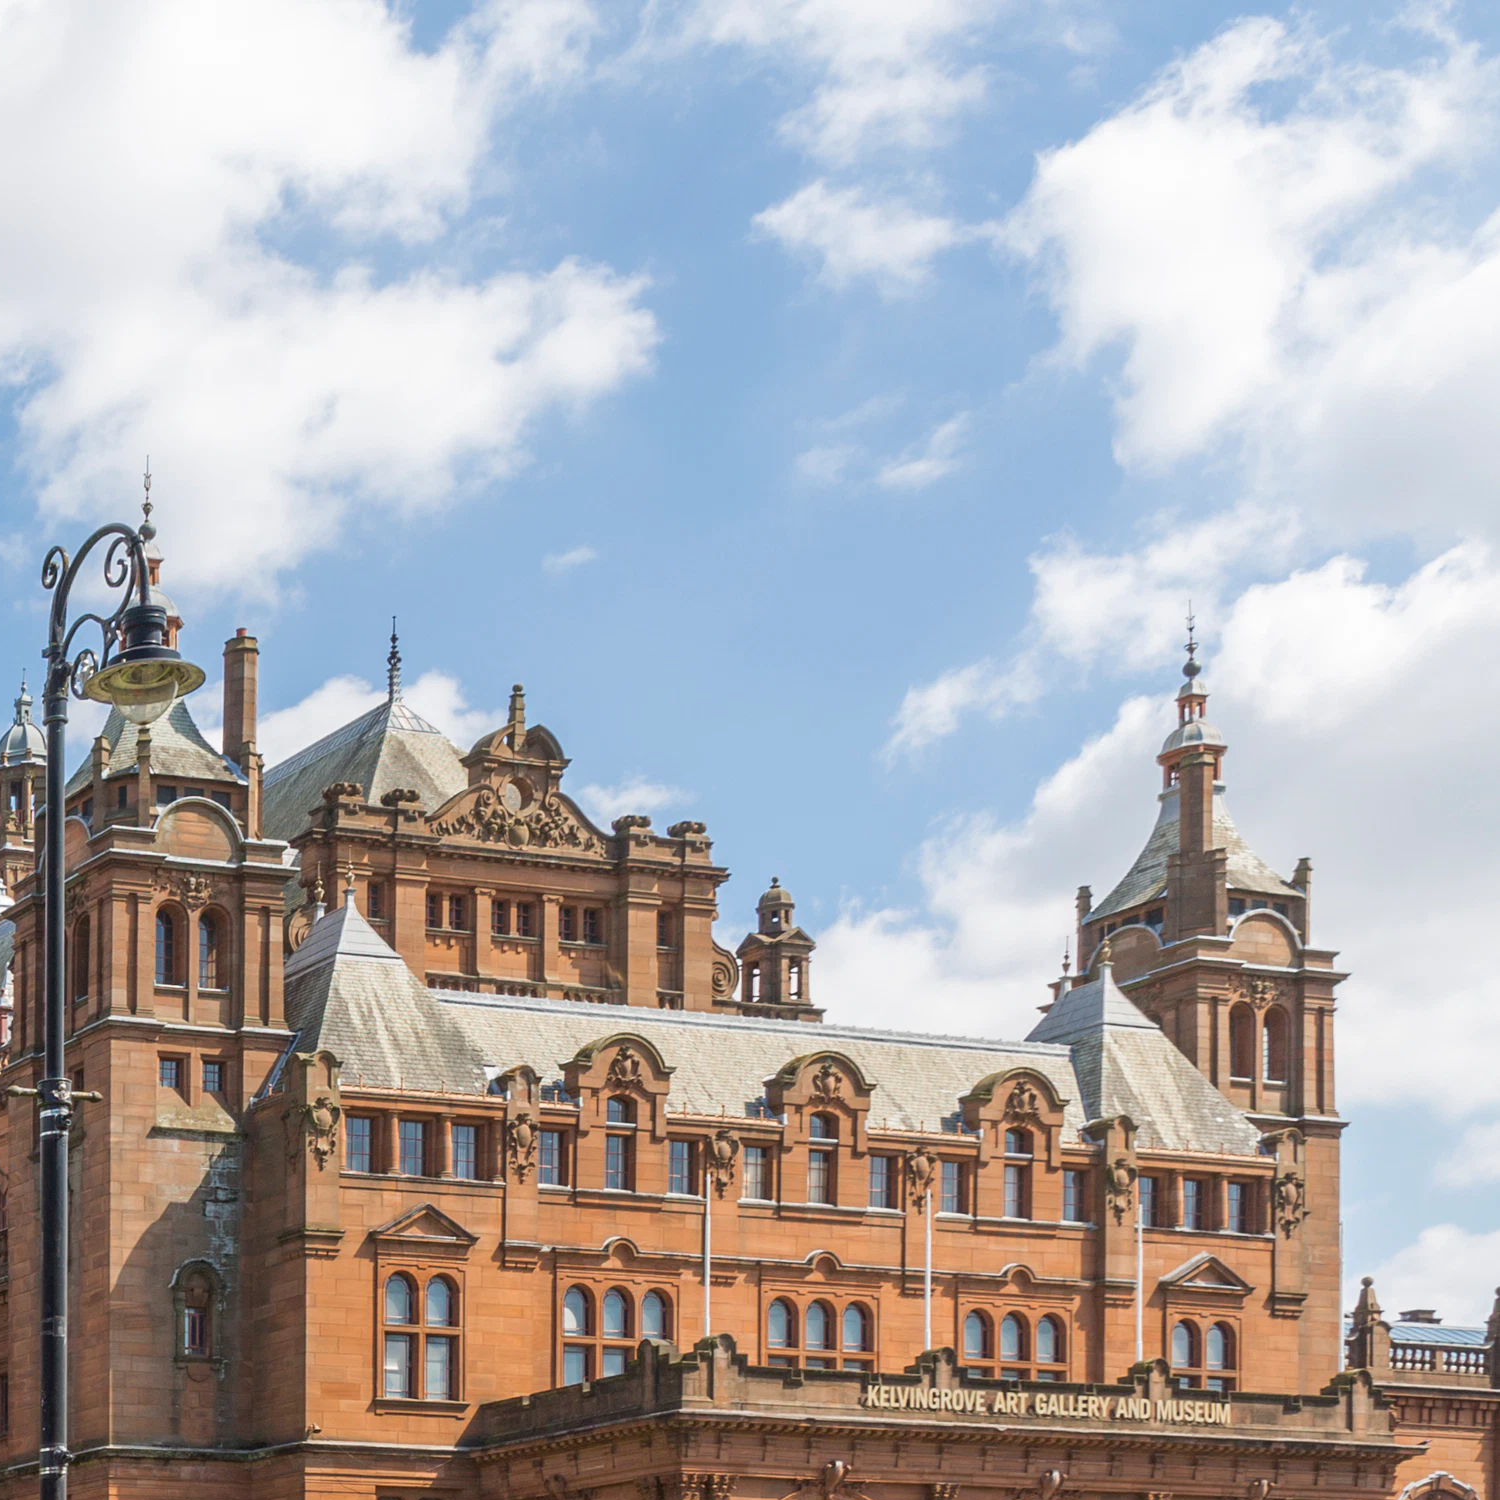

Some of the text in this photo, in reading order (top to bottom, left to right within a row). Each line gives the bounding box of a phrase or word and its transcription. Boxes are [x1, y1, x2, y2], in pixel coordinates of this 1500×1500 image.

[867, 1385, 1232, 1424] KELVINGROVE ART GALLERY AND MUSEUM
